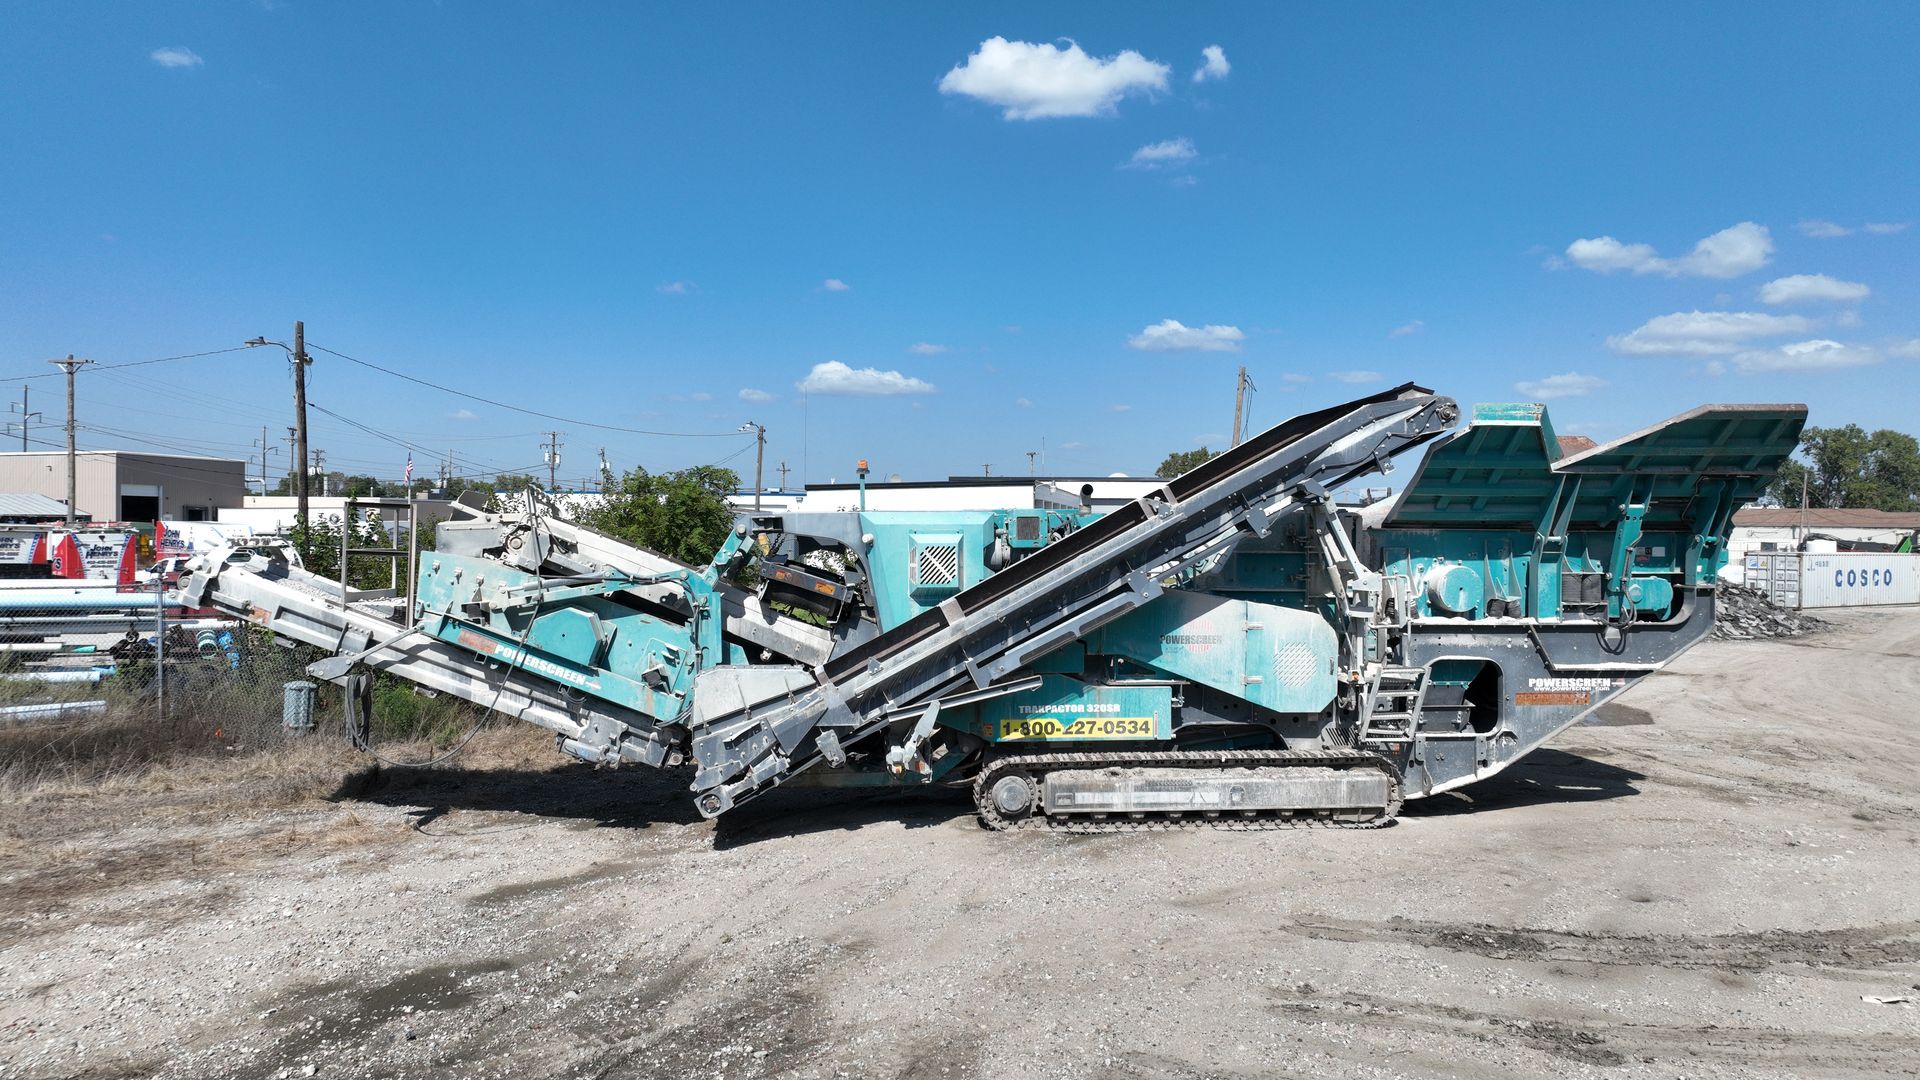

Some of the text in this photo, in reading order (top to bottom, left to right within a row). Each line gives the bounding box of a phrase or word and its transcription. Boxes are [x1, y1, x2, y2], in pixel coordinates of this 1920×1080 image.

[164, 526, 180, 538] JOHN
[1835, 569, 1892, 587] COSCO
[1160, 634, 1222, 645] POWERSCREEN
[494, 644, 586, 685] POWERSCREEN
[1528, 678, 1611, 687] POWERSCREEN
[1018, 703, 1121, 713] TRAKPACTOR 320SR
[1002, 720, 1150, 736] 1-800-227-0534
